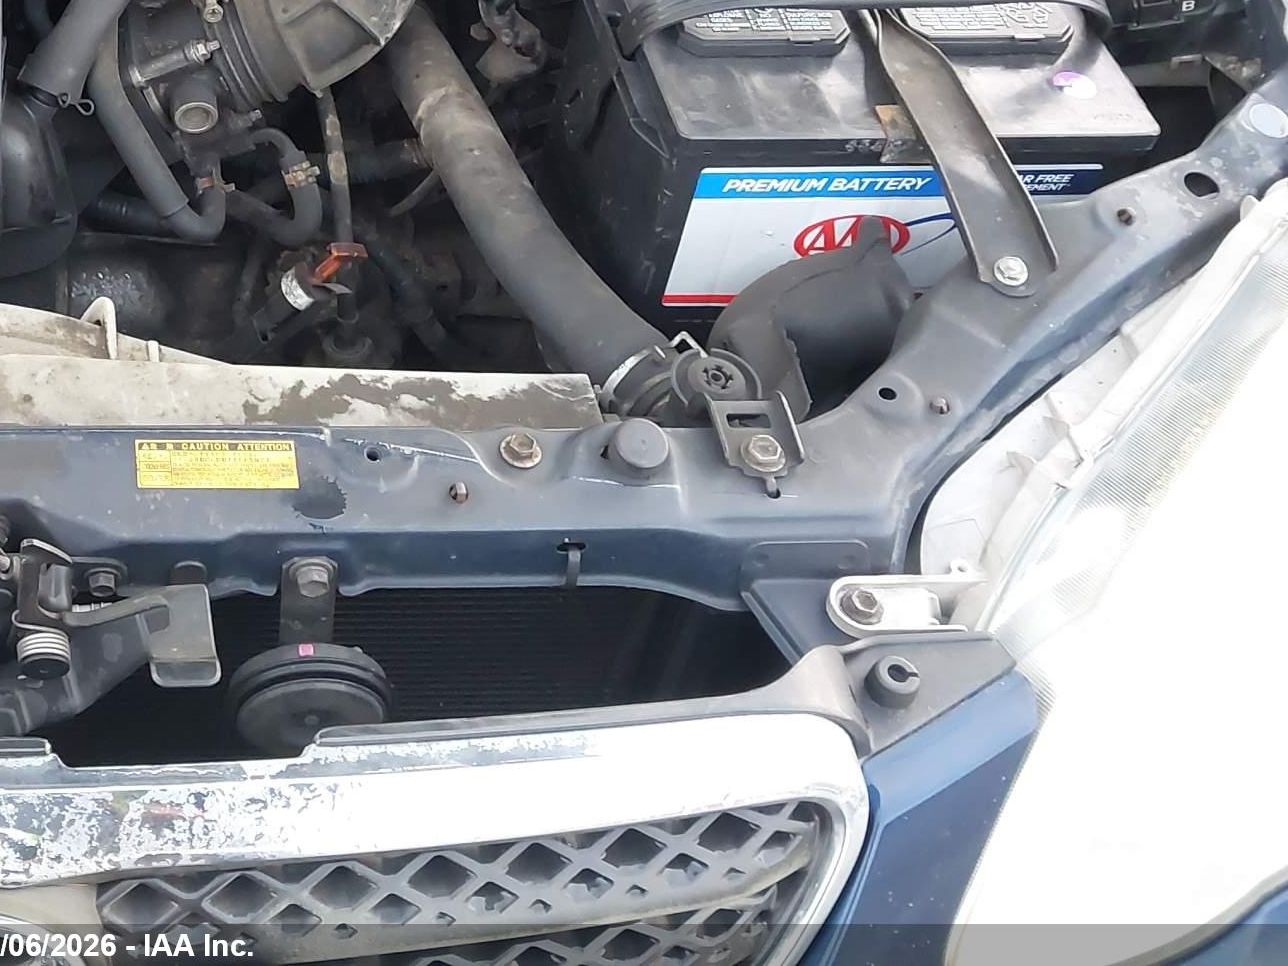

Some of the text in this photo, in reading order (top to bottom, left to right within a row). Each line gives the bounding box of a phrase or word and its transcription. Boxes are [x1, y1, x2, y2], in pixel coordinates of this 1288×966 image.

[1182, 0, 1196, 12] B
[1035, 174, 1074, 183] FREE
[722, 177, 932, 193] PREMIUM BATTERY
[181, 442, 290, 451] CAUTION ATTENTION
